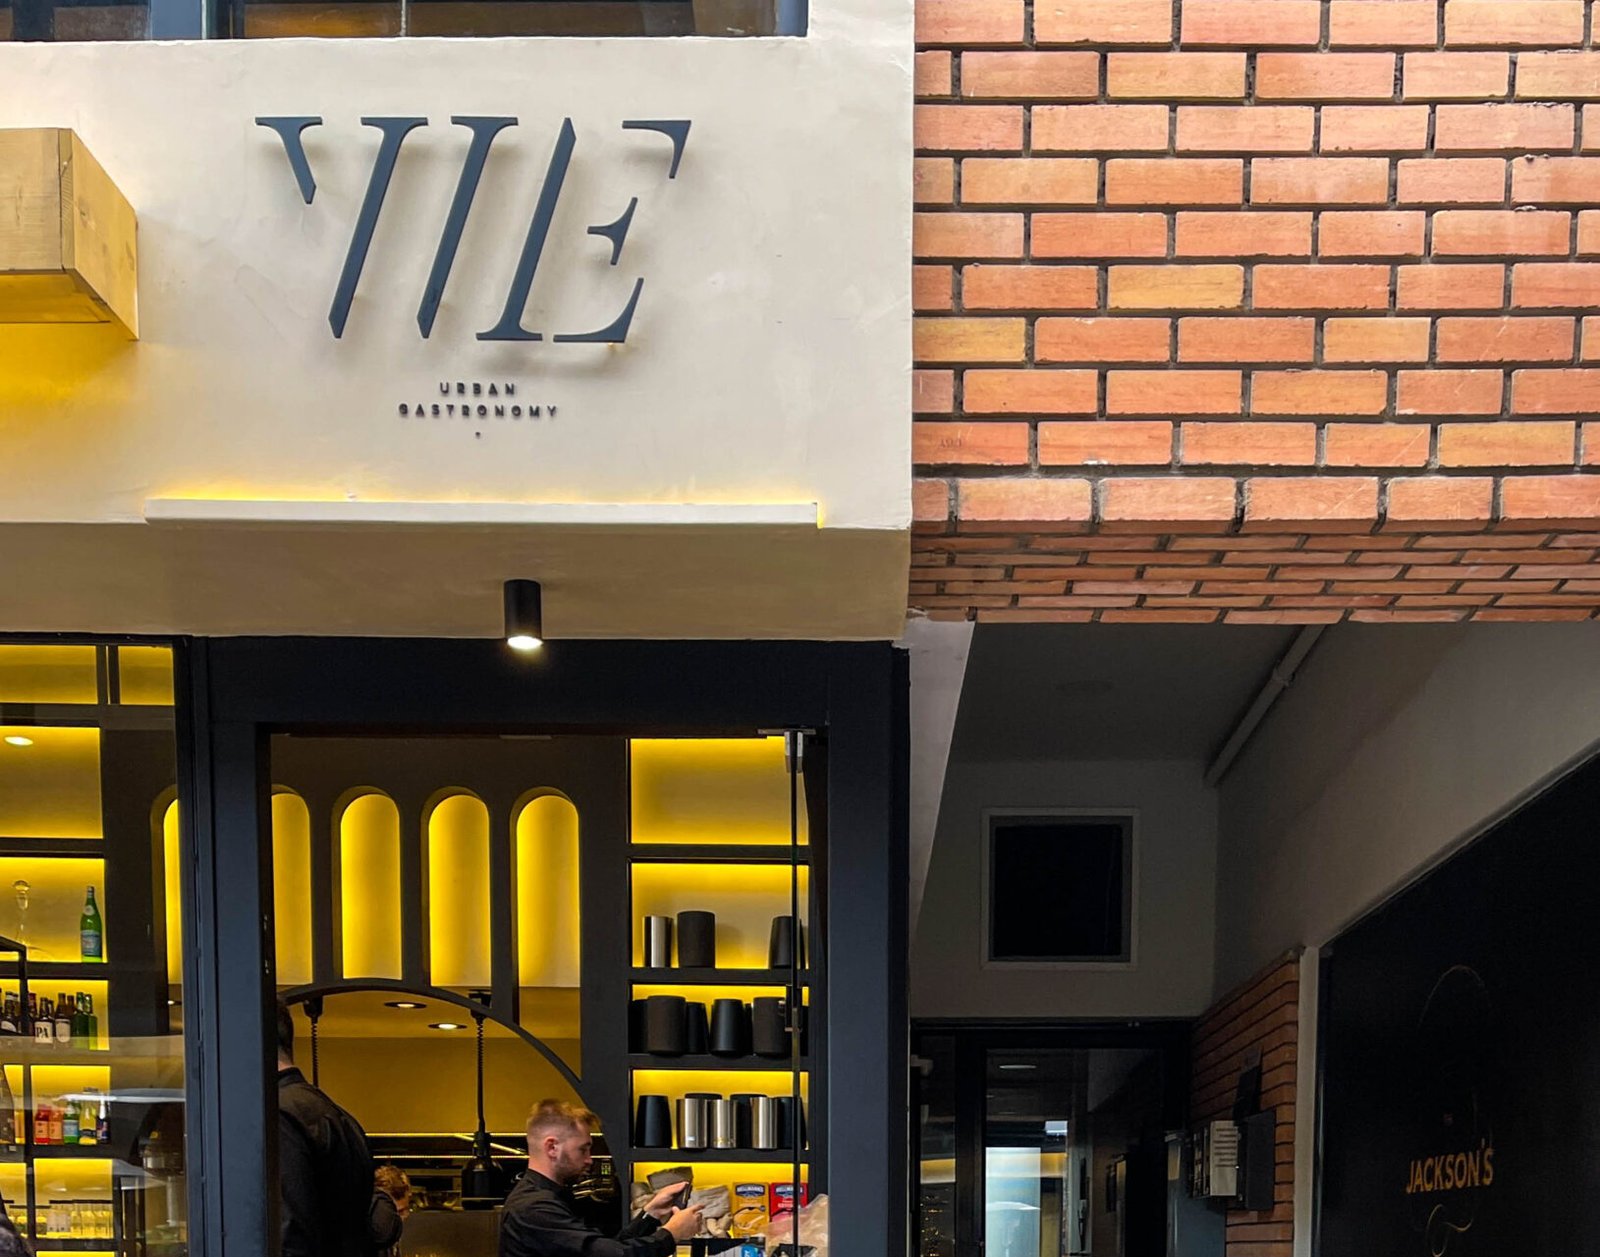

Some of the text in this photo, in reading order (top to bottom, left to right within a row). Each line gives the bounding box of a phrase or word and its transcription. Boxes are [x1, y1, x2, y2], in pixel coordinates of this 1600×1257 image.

[255, 116, 692, 343] VIE
[439, 382, 515, 396] URBAN
[398, 403, 557, 418] GASTRONOMY
[1405, 1138, 1495, 1194] JACKSON'S
